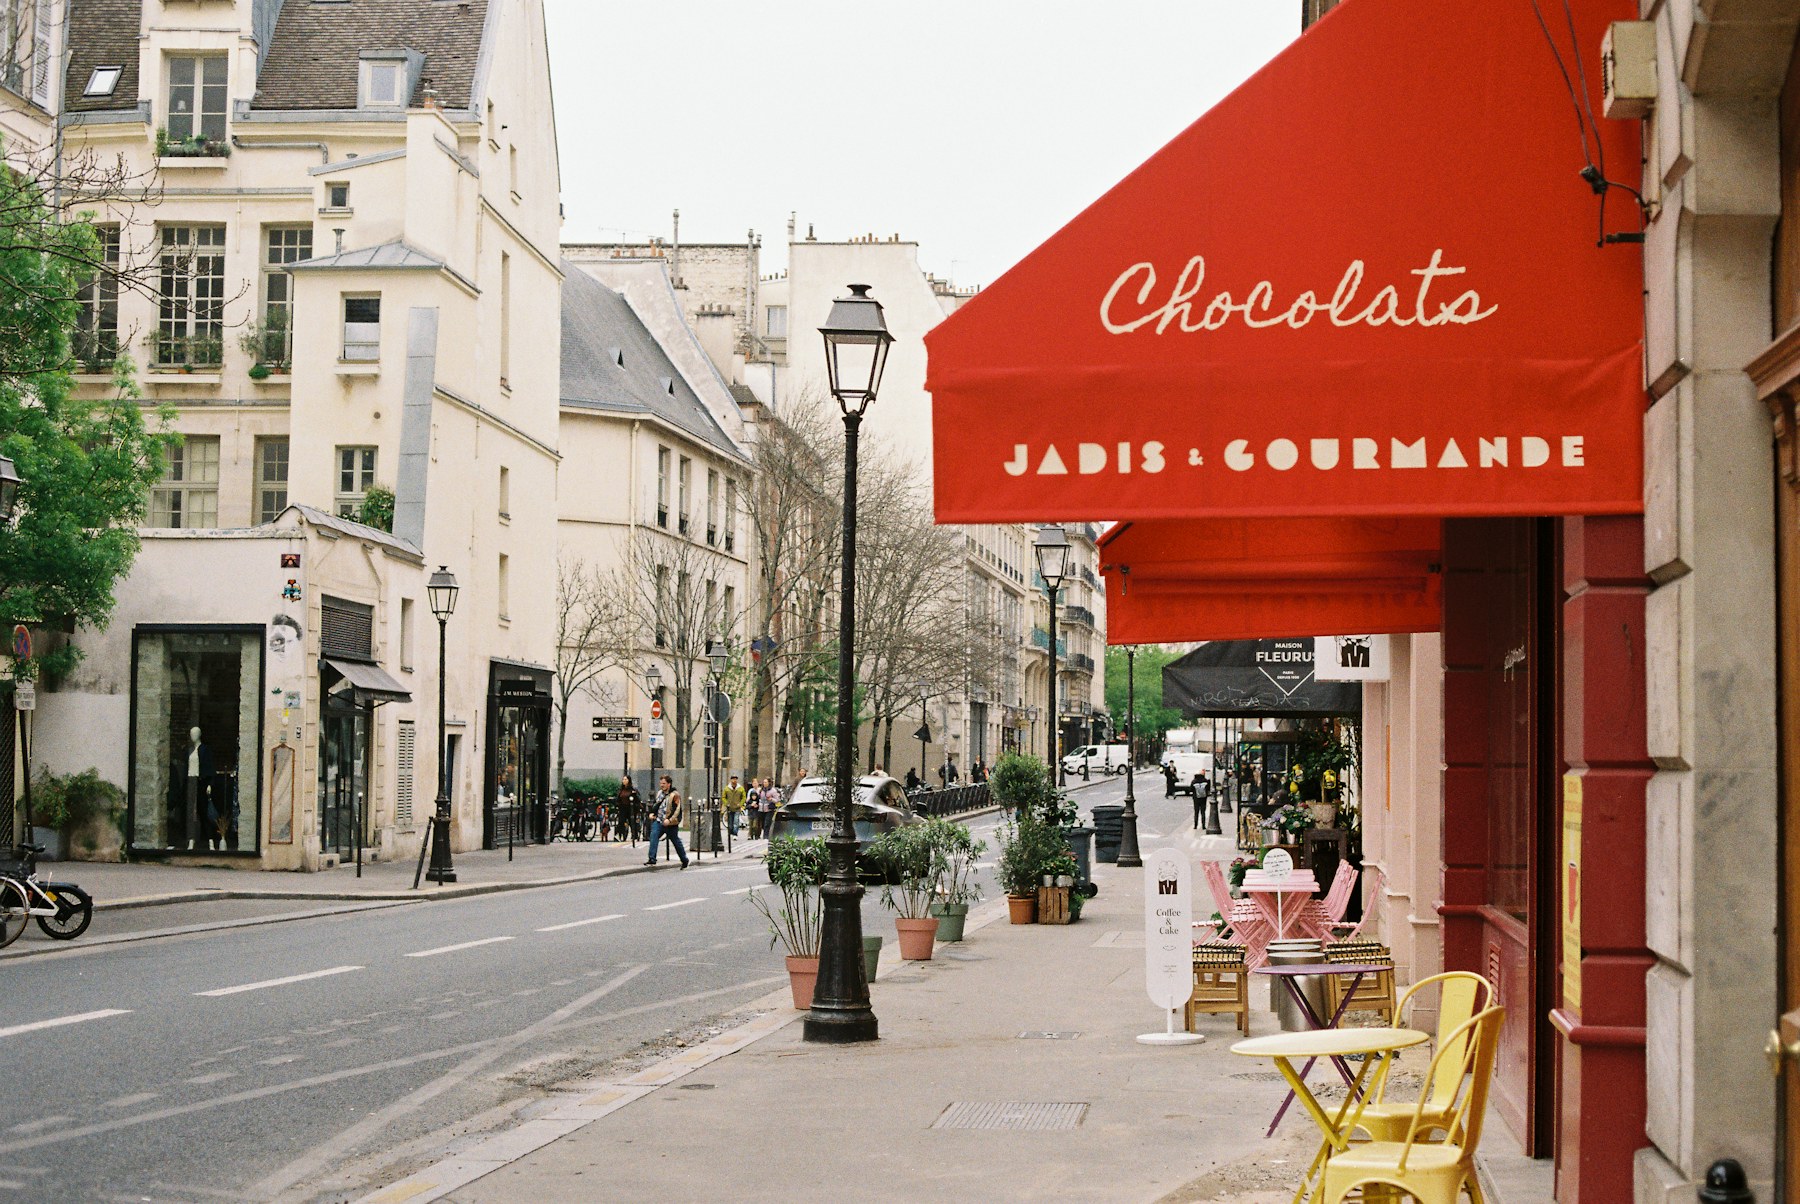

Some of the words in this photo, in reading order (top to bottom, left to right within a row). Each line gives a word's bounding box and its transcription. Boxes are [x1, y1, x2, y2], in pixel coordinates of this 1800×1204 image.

[1100, 248, 1499, 335] Chocolats
[1003, 440, 1167, 477] JADIS
[1188, 447, 1204, 467] &
[1223, 435, 1585, 472] GOURMANDE
[1156, 908, 1181, 917] Coffee
[1159, 926, 1179, 935] Cake
